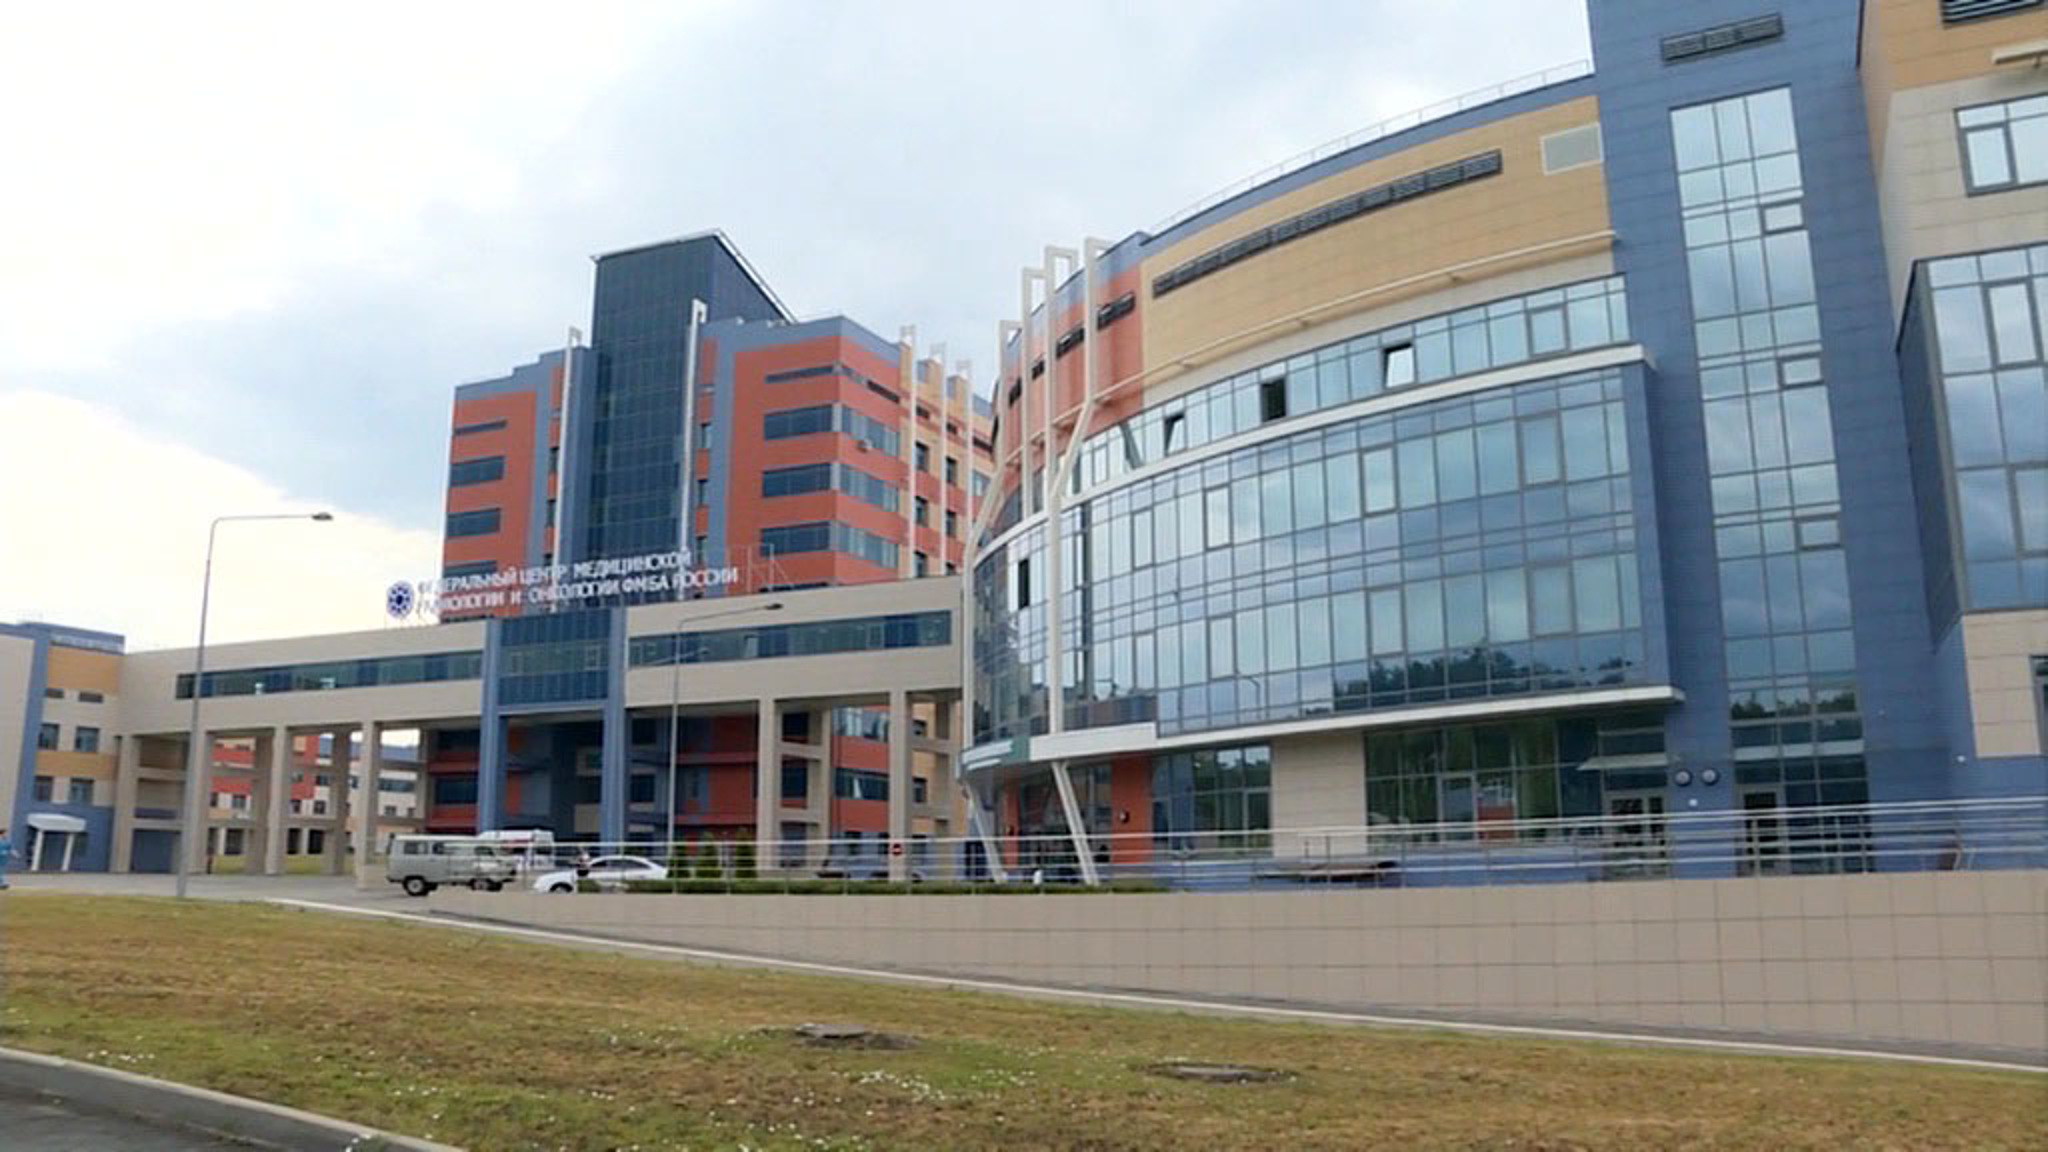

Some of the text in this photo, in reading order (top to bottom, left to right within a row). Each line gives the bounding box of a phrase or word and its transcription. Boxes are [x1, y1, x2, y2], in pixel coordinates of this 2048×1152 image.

[519, 564, 568, 584] ЦЕНТР
[574, 549, 691, 578] МЕДИЦИНСКОЙ
[417, 590, 505, 614] ОЛОГИИ
[527, 577, 619, 604] ОНКОЛОГИИ
[622, 574, 669, 593] ФМБА
[672, 566, 738, 589] РОССИИ
